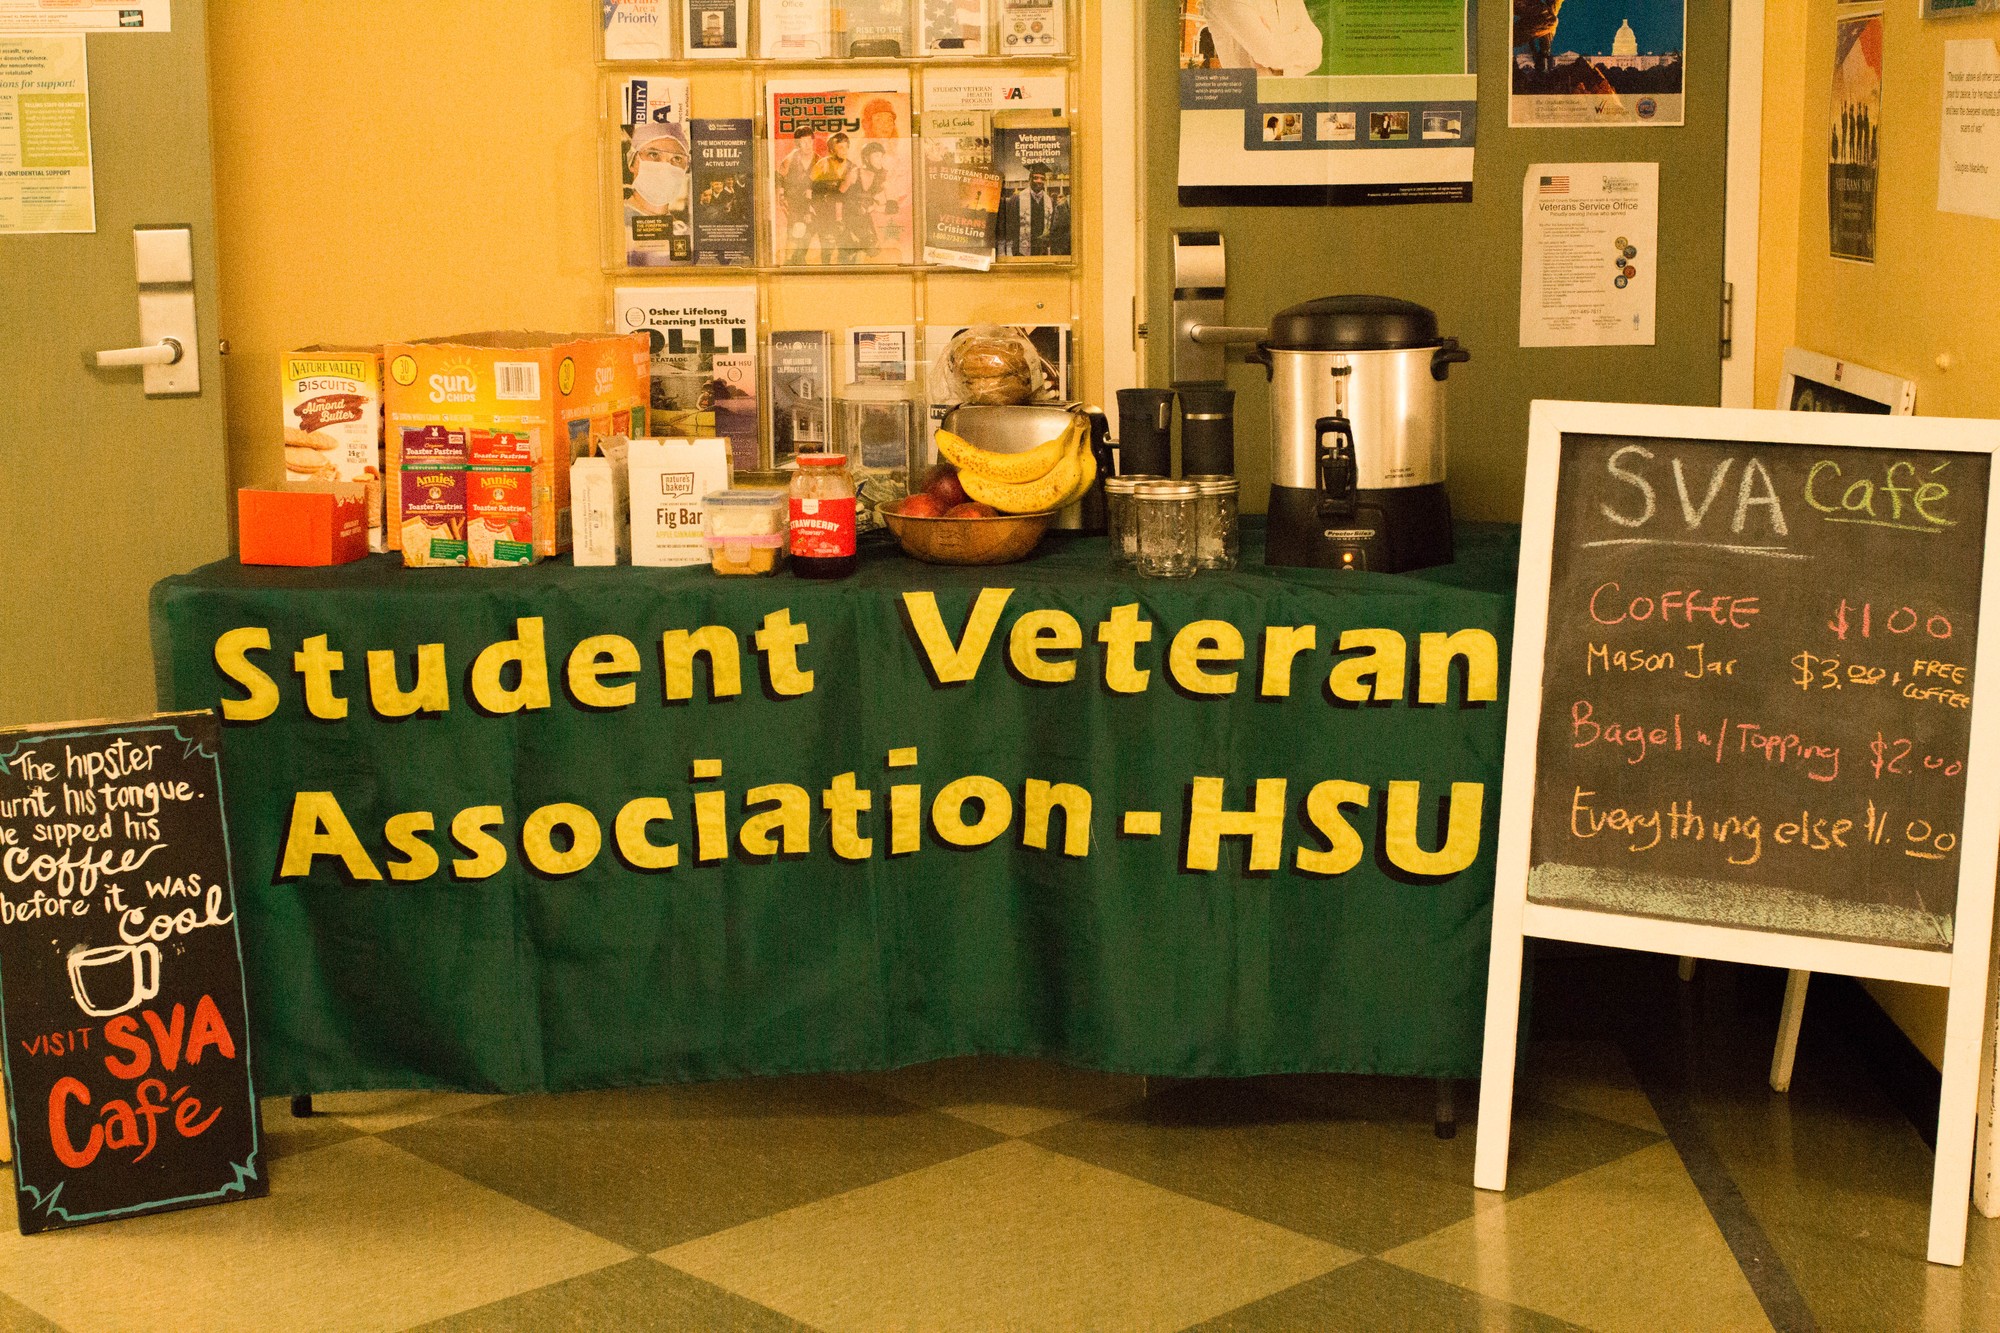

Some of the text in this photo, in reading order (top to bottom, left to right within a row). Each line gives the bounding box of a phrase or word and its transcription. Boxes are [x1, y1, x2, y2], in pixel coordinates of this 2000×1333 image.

[617, 12, 659, 26] Priority
[876, 26, 886, 34] TO
[20, 80, 35, 90] for
[36, 80, 76, 89] support!
[779, 106, 845, 117] ROLLER
[951, 117, 975, 127] Guide
[1018, 134, 1057, 142] Veterans
[702, 148, 714, 158] GI
[1014, 142, 1061, 150] Enrollment
[939, 173, 961, 181] TODAY
[950, 168, 1000, 181] VETERANS DIED
[1539, 201, 1639, 211] Veterans Service Office
[939, 214, 987, 229] VETERANS
[937, 222, 985, 238] Crisis Line
[649, 307, 728, 317] Osher Lifelong
[649, 317, 747, 327] Learning Institute
[292, 361, 363, 379] NATURE VALLEY
[428, 373, 478, 404] Sun
[446, 393, 476, 403] CHIPS
[302, 399, 346, 415] Almond
[319, 411, 355, 423] Butter
[405, 447, 463, 455] Toaster Pastries
[416, 472, 456, 488] Annie's
[480, 474, 518, 489] Annie's
[665, 474, 690, 484] nature's
[665, 482, 690, 493] bakery
[1602, 443, 1958, 537] SVA Café
[435, 503, 463, 511] Pastries
[498, 504, 526, 512] Pastries
[656, 507, 704, 529] Fig Bar
[790, 518, 840, 533] STRAWBERRY
[1589, 581, 1760, 628] COFFEE
[213, 587, 1499, 723] Student Veteran
[1587, 642, 1675, 677] Mason
[1684, 642, 1738, 680] Jar
[1912, 659, 1968, 685] FREE
[1902, 682, 1971, 709] COFFEE
[1571, 700, 1682, 765] Bagel
[10, 737, 162, 788] The hipster
[63, 783, 97, 816] his
[98, 780, 205, 817] tongue.
[32, 813, 112, 848] sipped
[125, 811, 161, 841] his
[1570, 785, 1762, 866] Everything
[1773, 810, 1854, 850] else
[3, 844, 169, 897] Coffee
[0, 889, 91, 925] before
[104, 883, 129, 914] it
[118, 884, 235, 945] Cool
[21, 994, 236, 1080] VISIT SVA
[48, 1076, 223, 1169] Café
